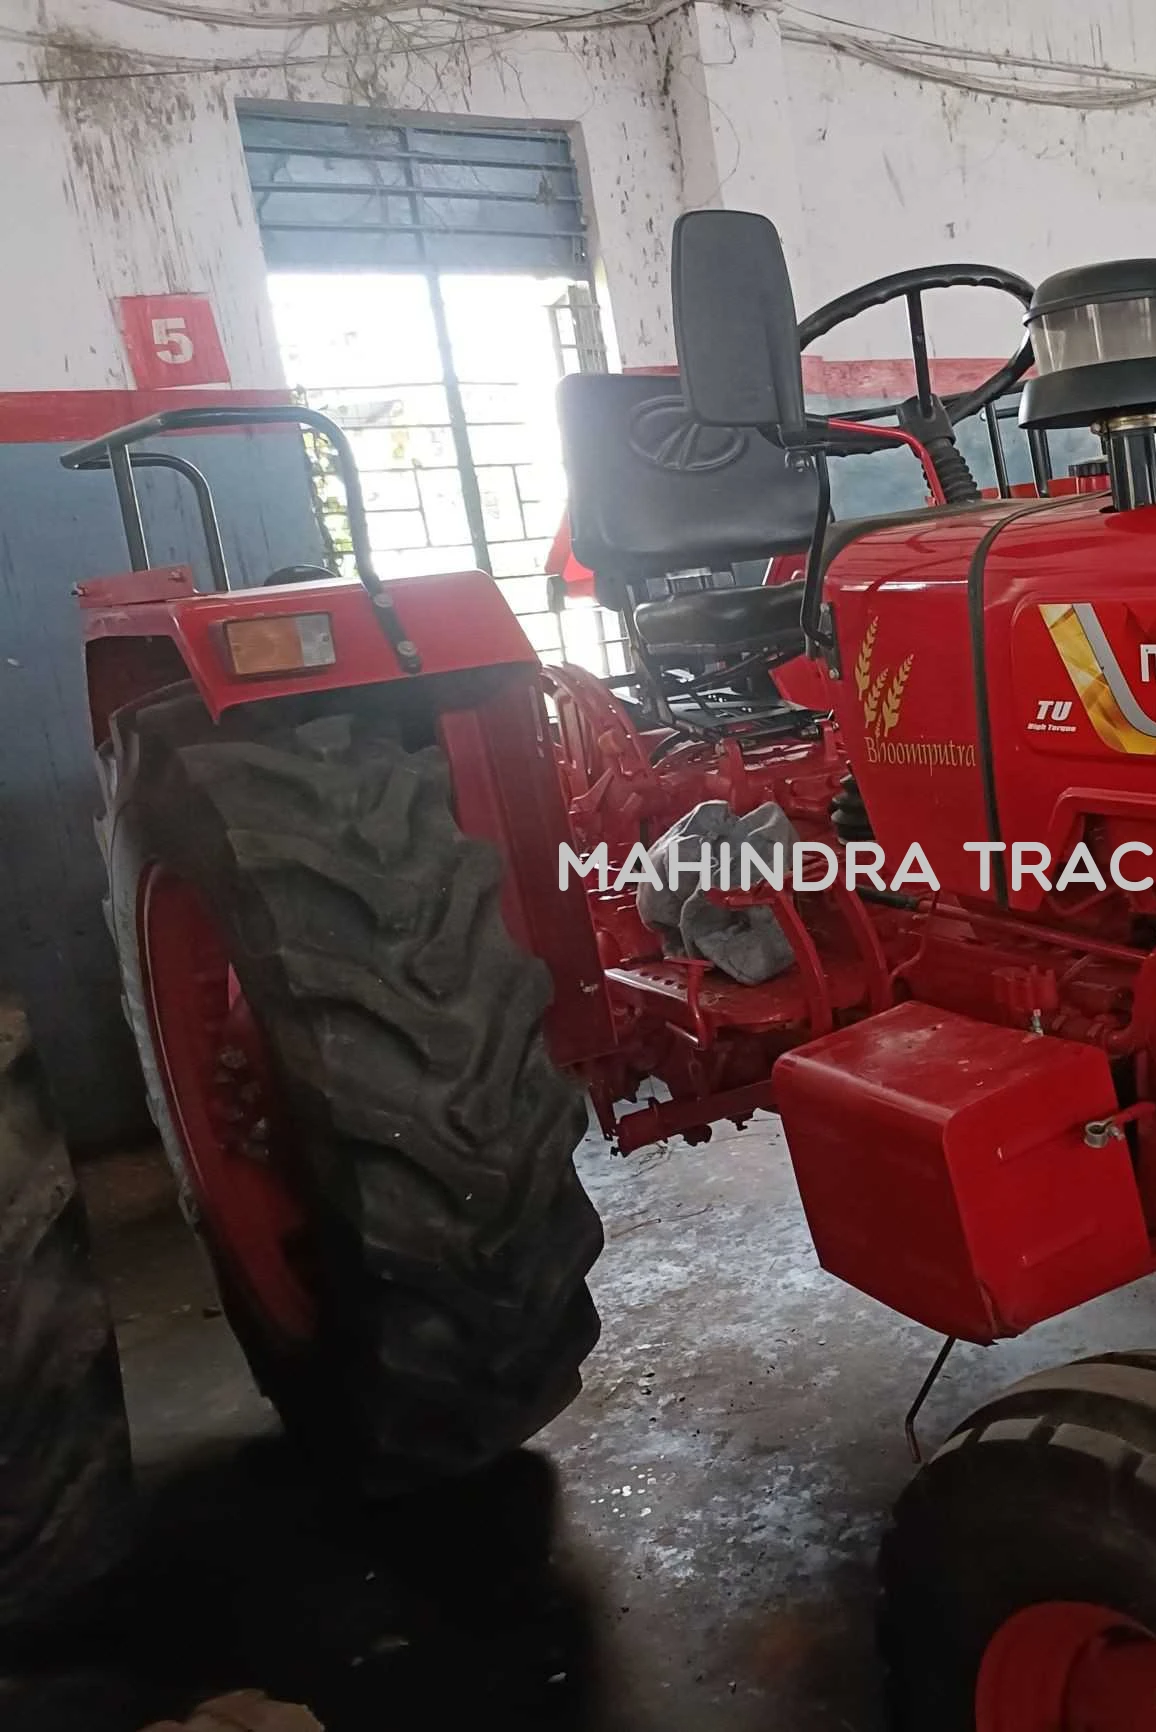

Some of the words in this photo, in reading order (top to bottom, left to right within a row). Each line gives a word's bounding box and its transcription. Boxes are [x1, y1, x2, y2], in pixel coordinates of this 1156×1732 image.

[151, 317, 194, 364] 5
[1036, 700, 1073, 721] TU
[864, 736, 977, 777] Bhoomiputra
